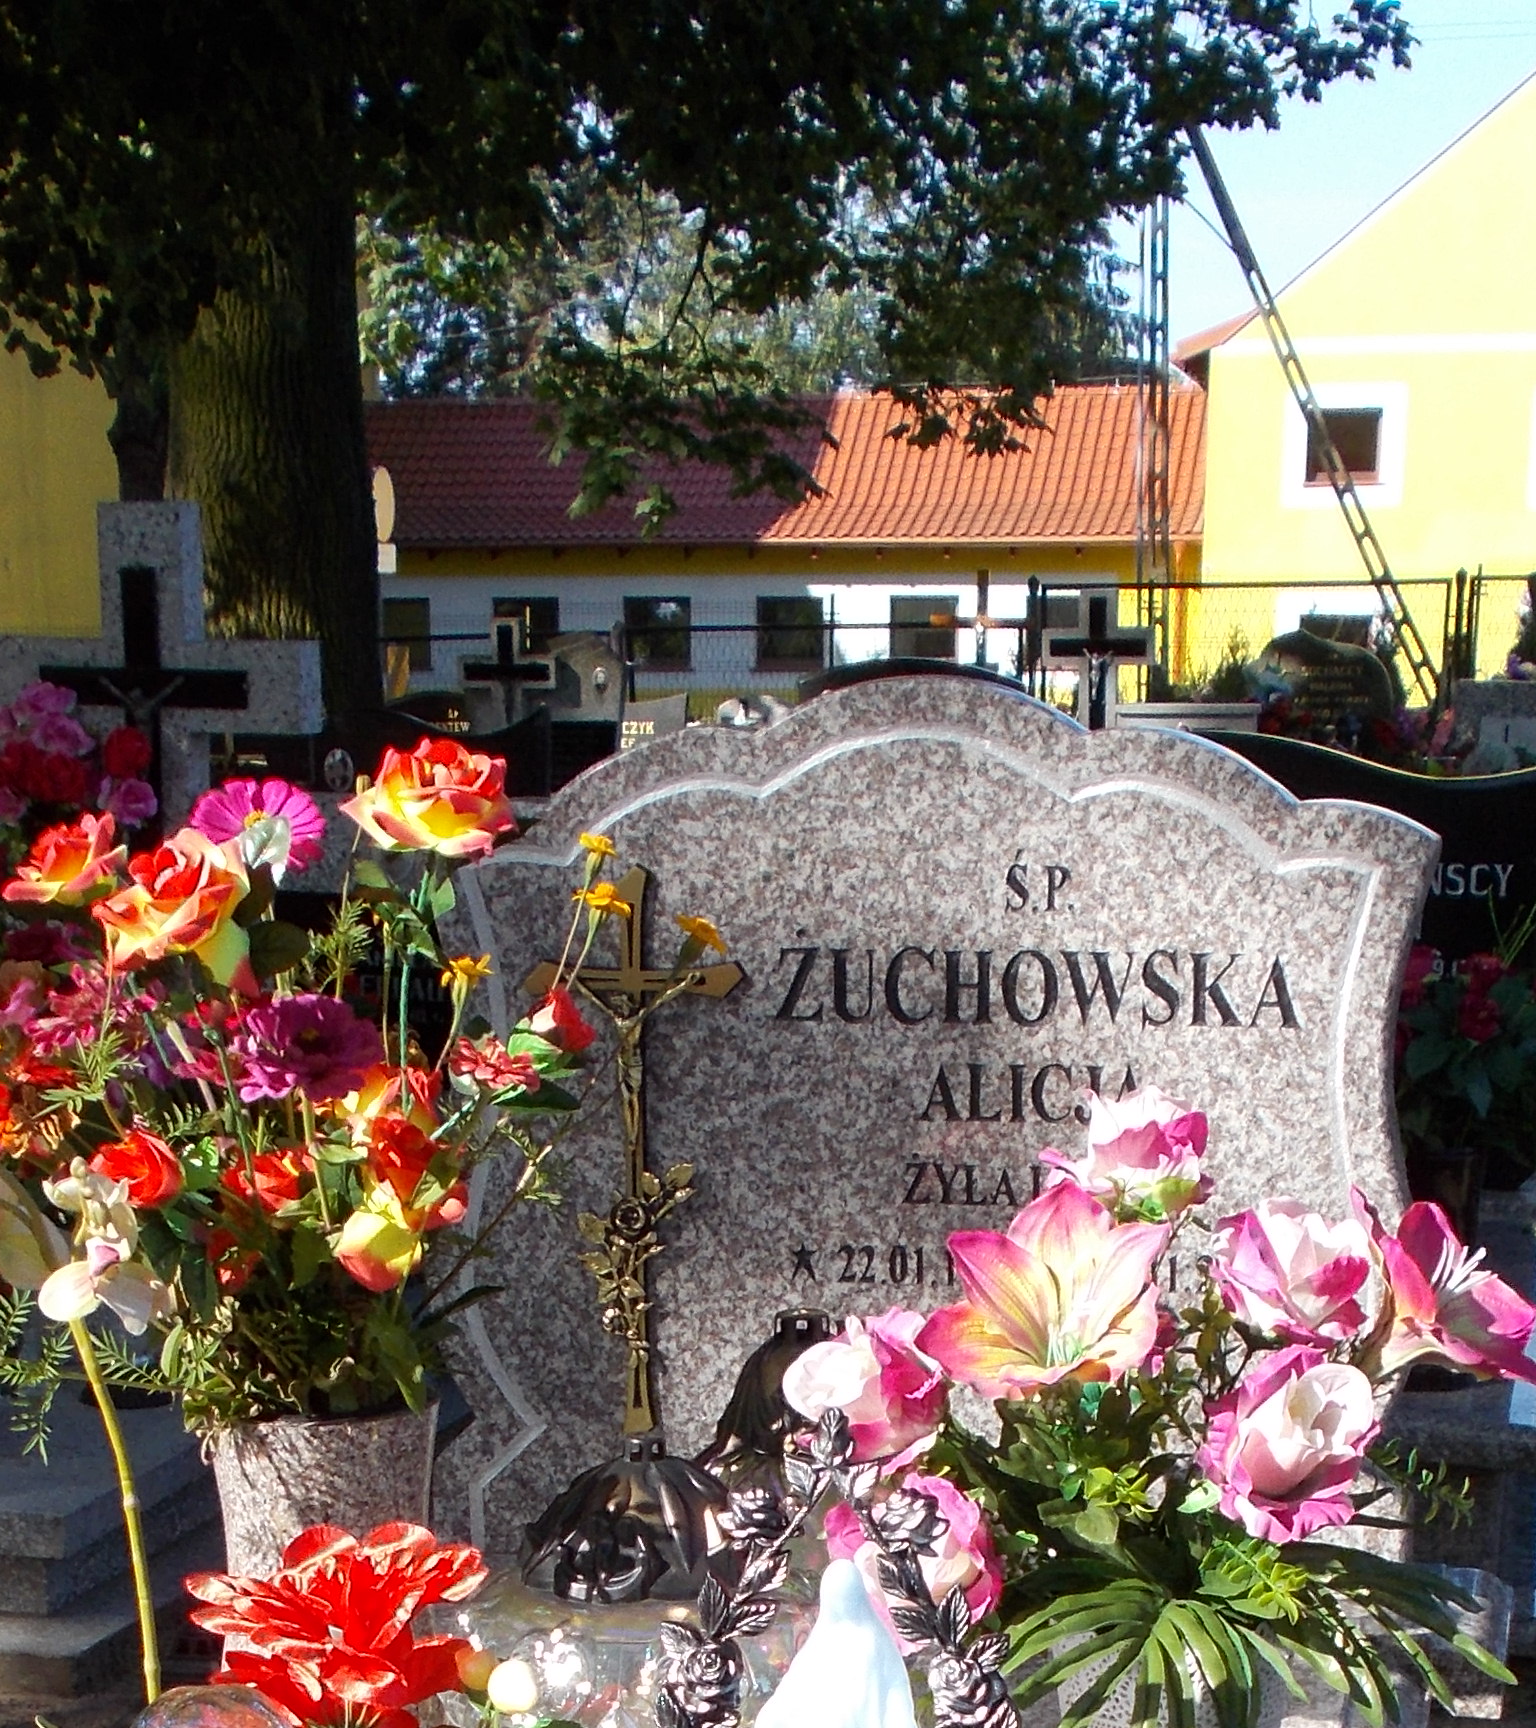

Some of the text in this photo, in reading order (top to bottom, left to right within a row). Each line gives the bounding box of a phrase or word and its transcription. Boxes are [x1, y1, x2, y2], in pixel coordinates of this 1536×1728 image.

[621, 721, 655, 735] CZYK
[1431, 862, 1515, 897] NSCY
[774, 928, 1304, 1029] ŻUCHOWSKA
